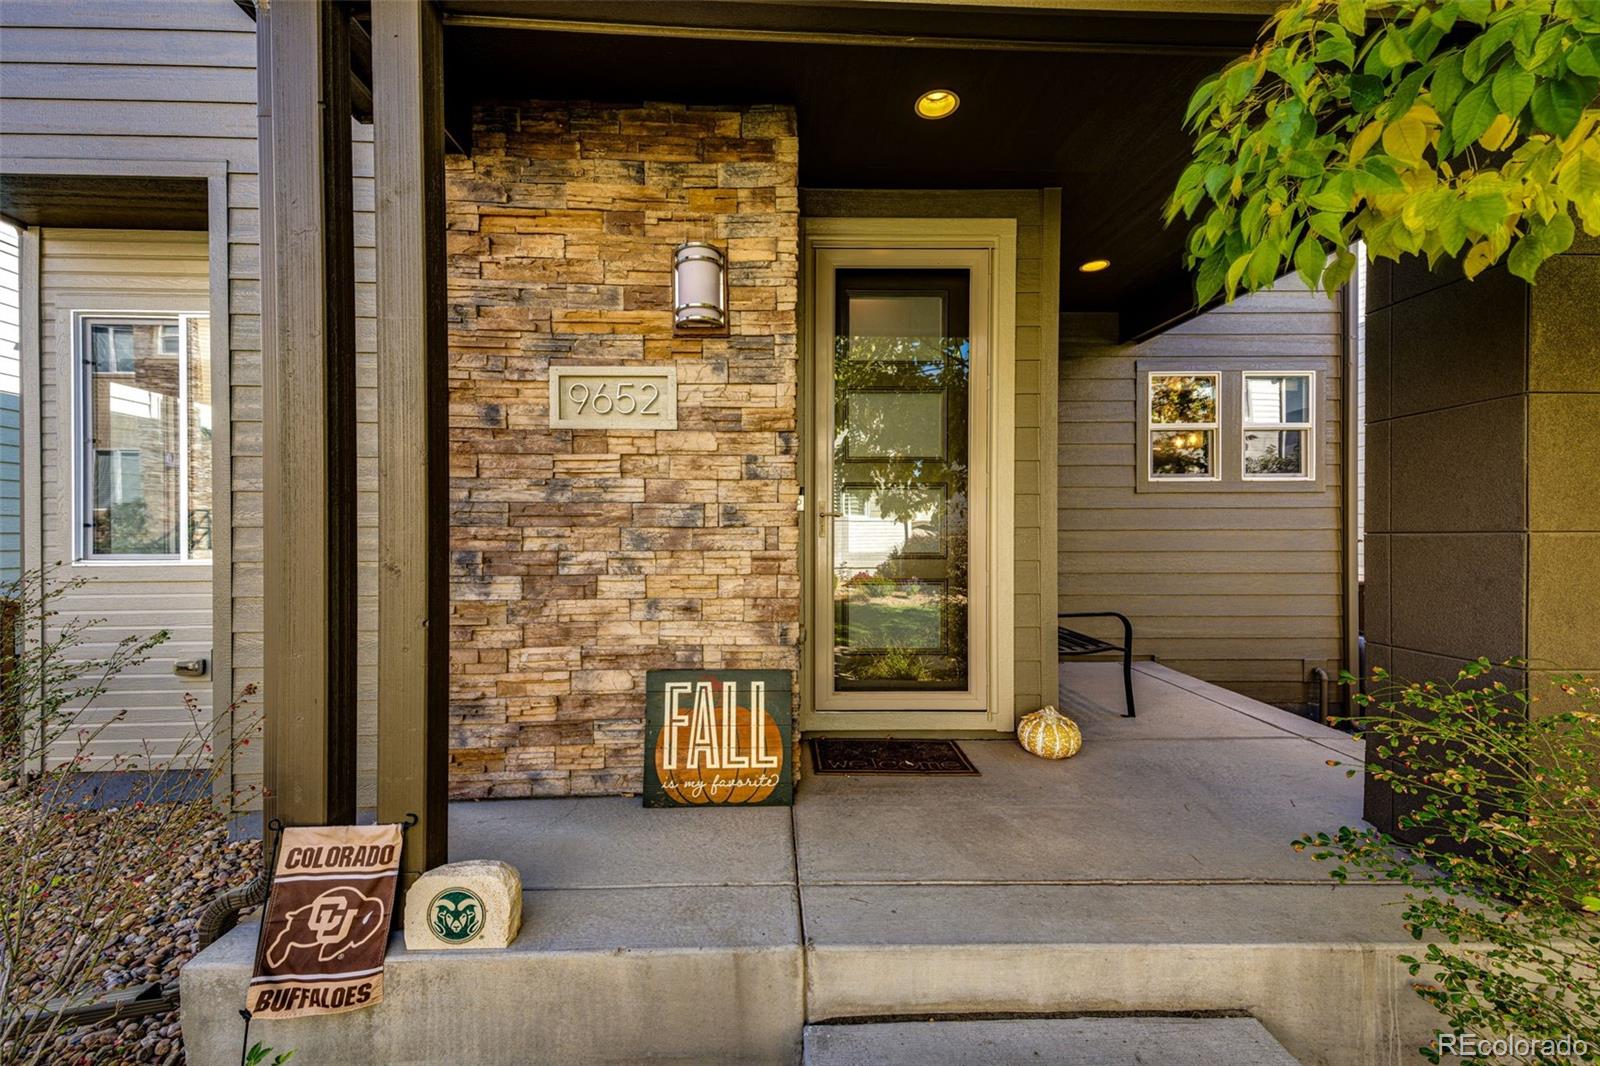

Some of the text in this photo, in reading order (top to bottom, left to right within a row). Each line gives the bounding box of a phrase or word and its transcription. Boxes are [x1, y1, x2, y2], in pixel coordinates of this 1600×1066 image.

[568, 382, 659, 415] 9652
[663, 681, 778, 770] FALL
[826, 759, 961, 770] welcome
[661, 774, 780, 798] is my favorite
[284, 844, 396, 870] COLORADO
[307, 896, 358, 944] CU
[253, 982, 373, 1013] BUFFALOES
